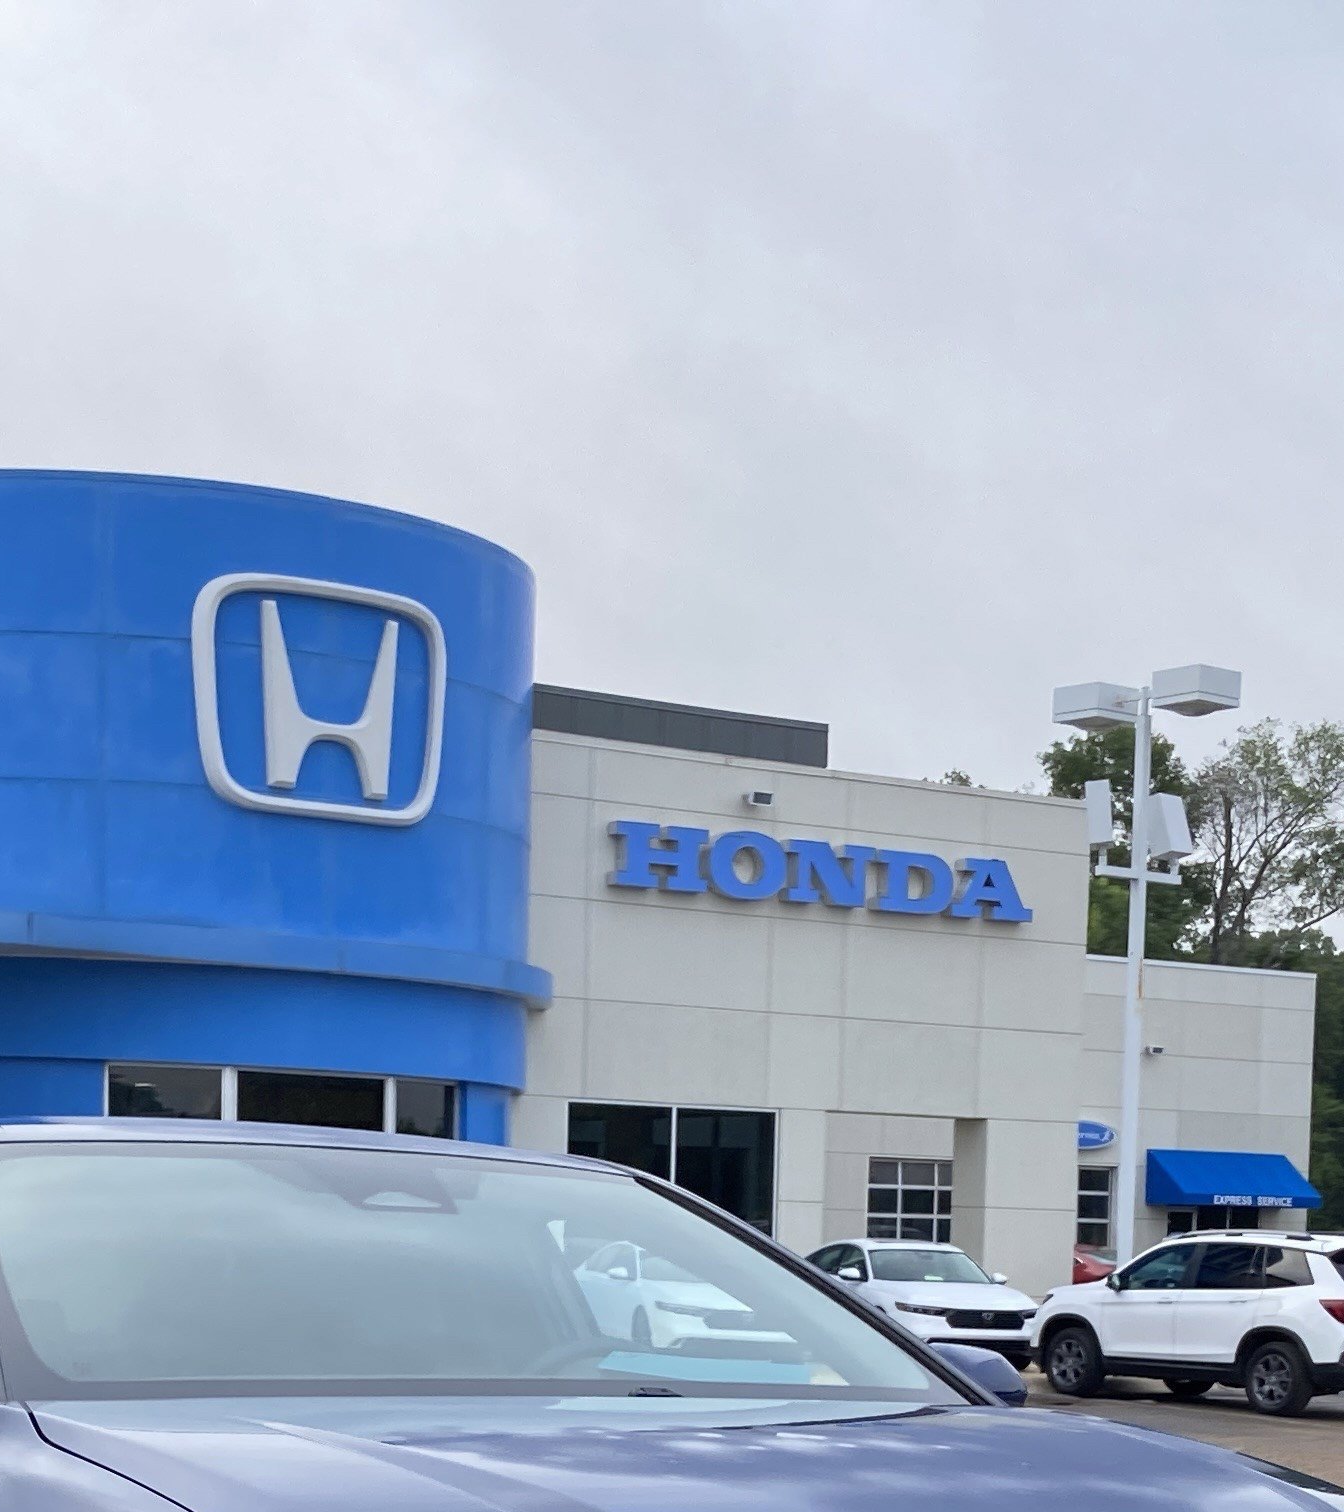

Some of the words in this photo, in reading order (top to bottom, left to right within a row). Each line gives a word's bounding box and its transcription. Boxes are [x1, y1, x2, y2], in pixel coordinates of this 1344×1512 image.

[608, 820, 1034, 923] HONDA
[1213, 1194, 1253, 1206] EXPRESS
[1257, 1195, 1293, 1207] SERVICE
